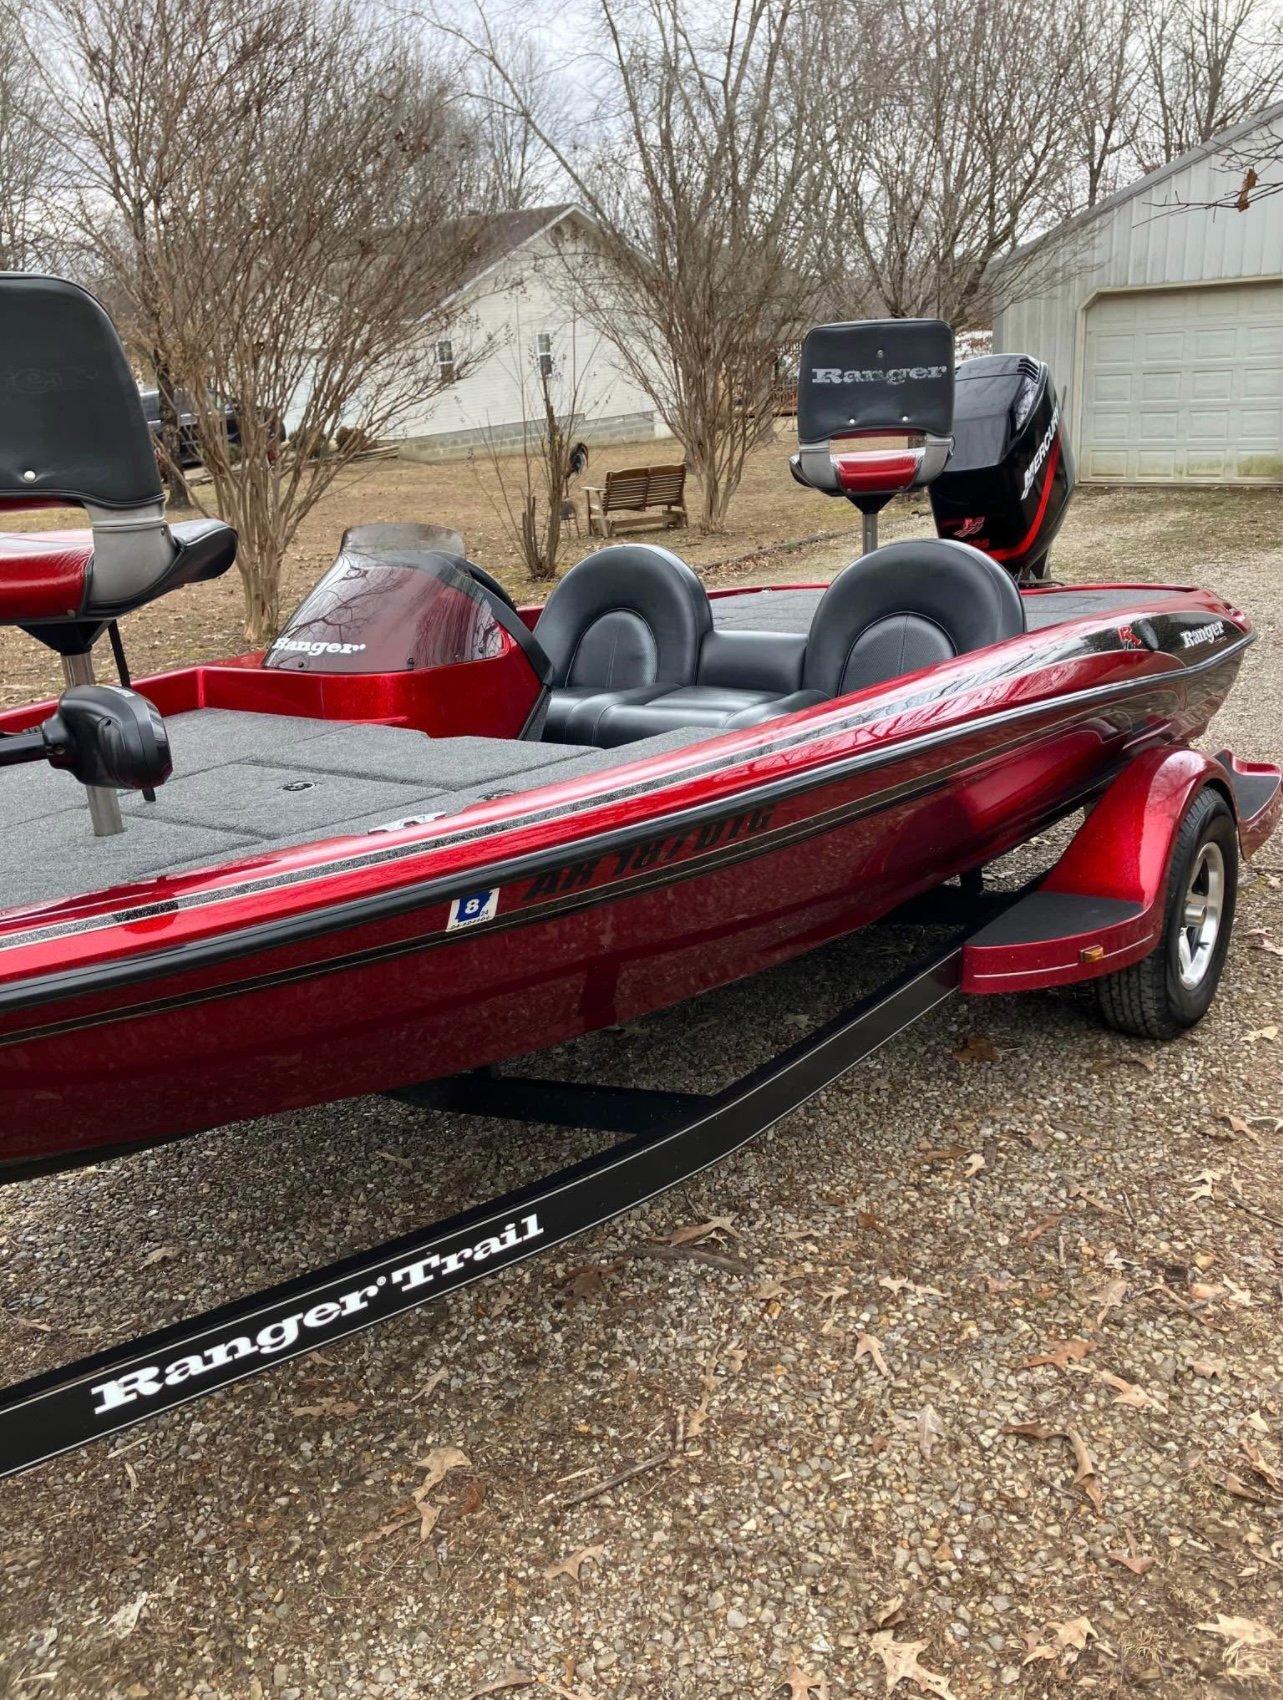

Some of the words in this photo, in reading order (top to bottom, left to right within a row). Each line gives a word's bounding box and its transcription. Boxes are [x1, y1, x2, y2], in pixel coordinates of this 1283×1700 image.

[811, 364, 948, 385] Ranger
[1180, 620, 1225, 648] Ranger
[271, 637, 360, 656] Ranger
[464, 898, 480, 914] 8
[391, 1213, 545, 1293] Trail
